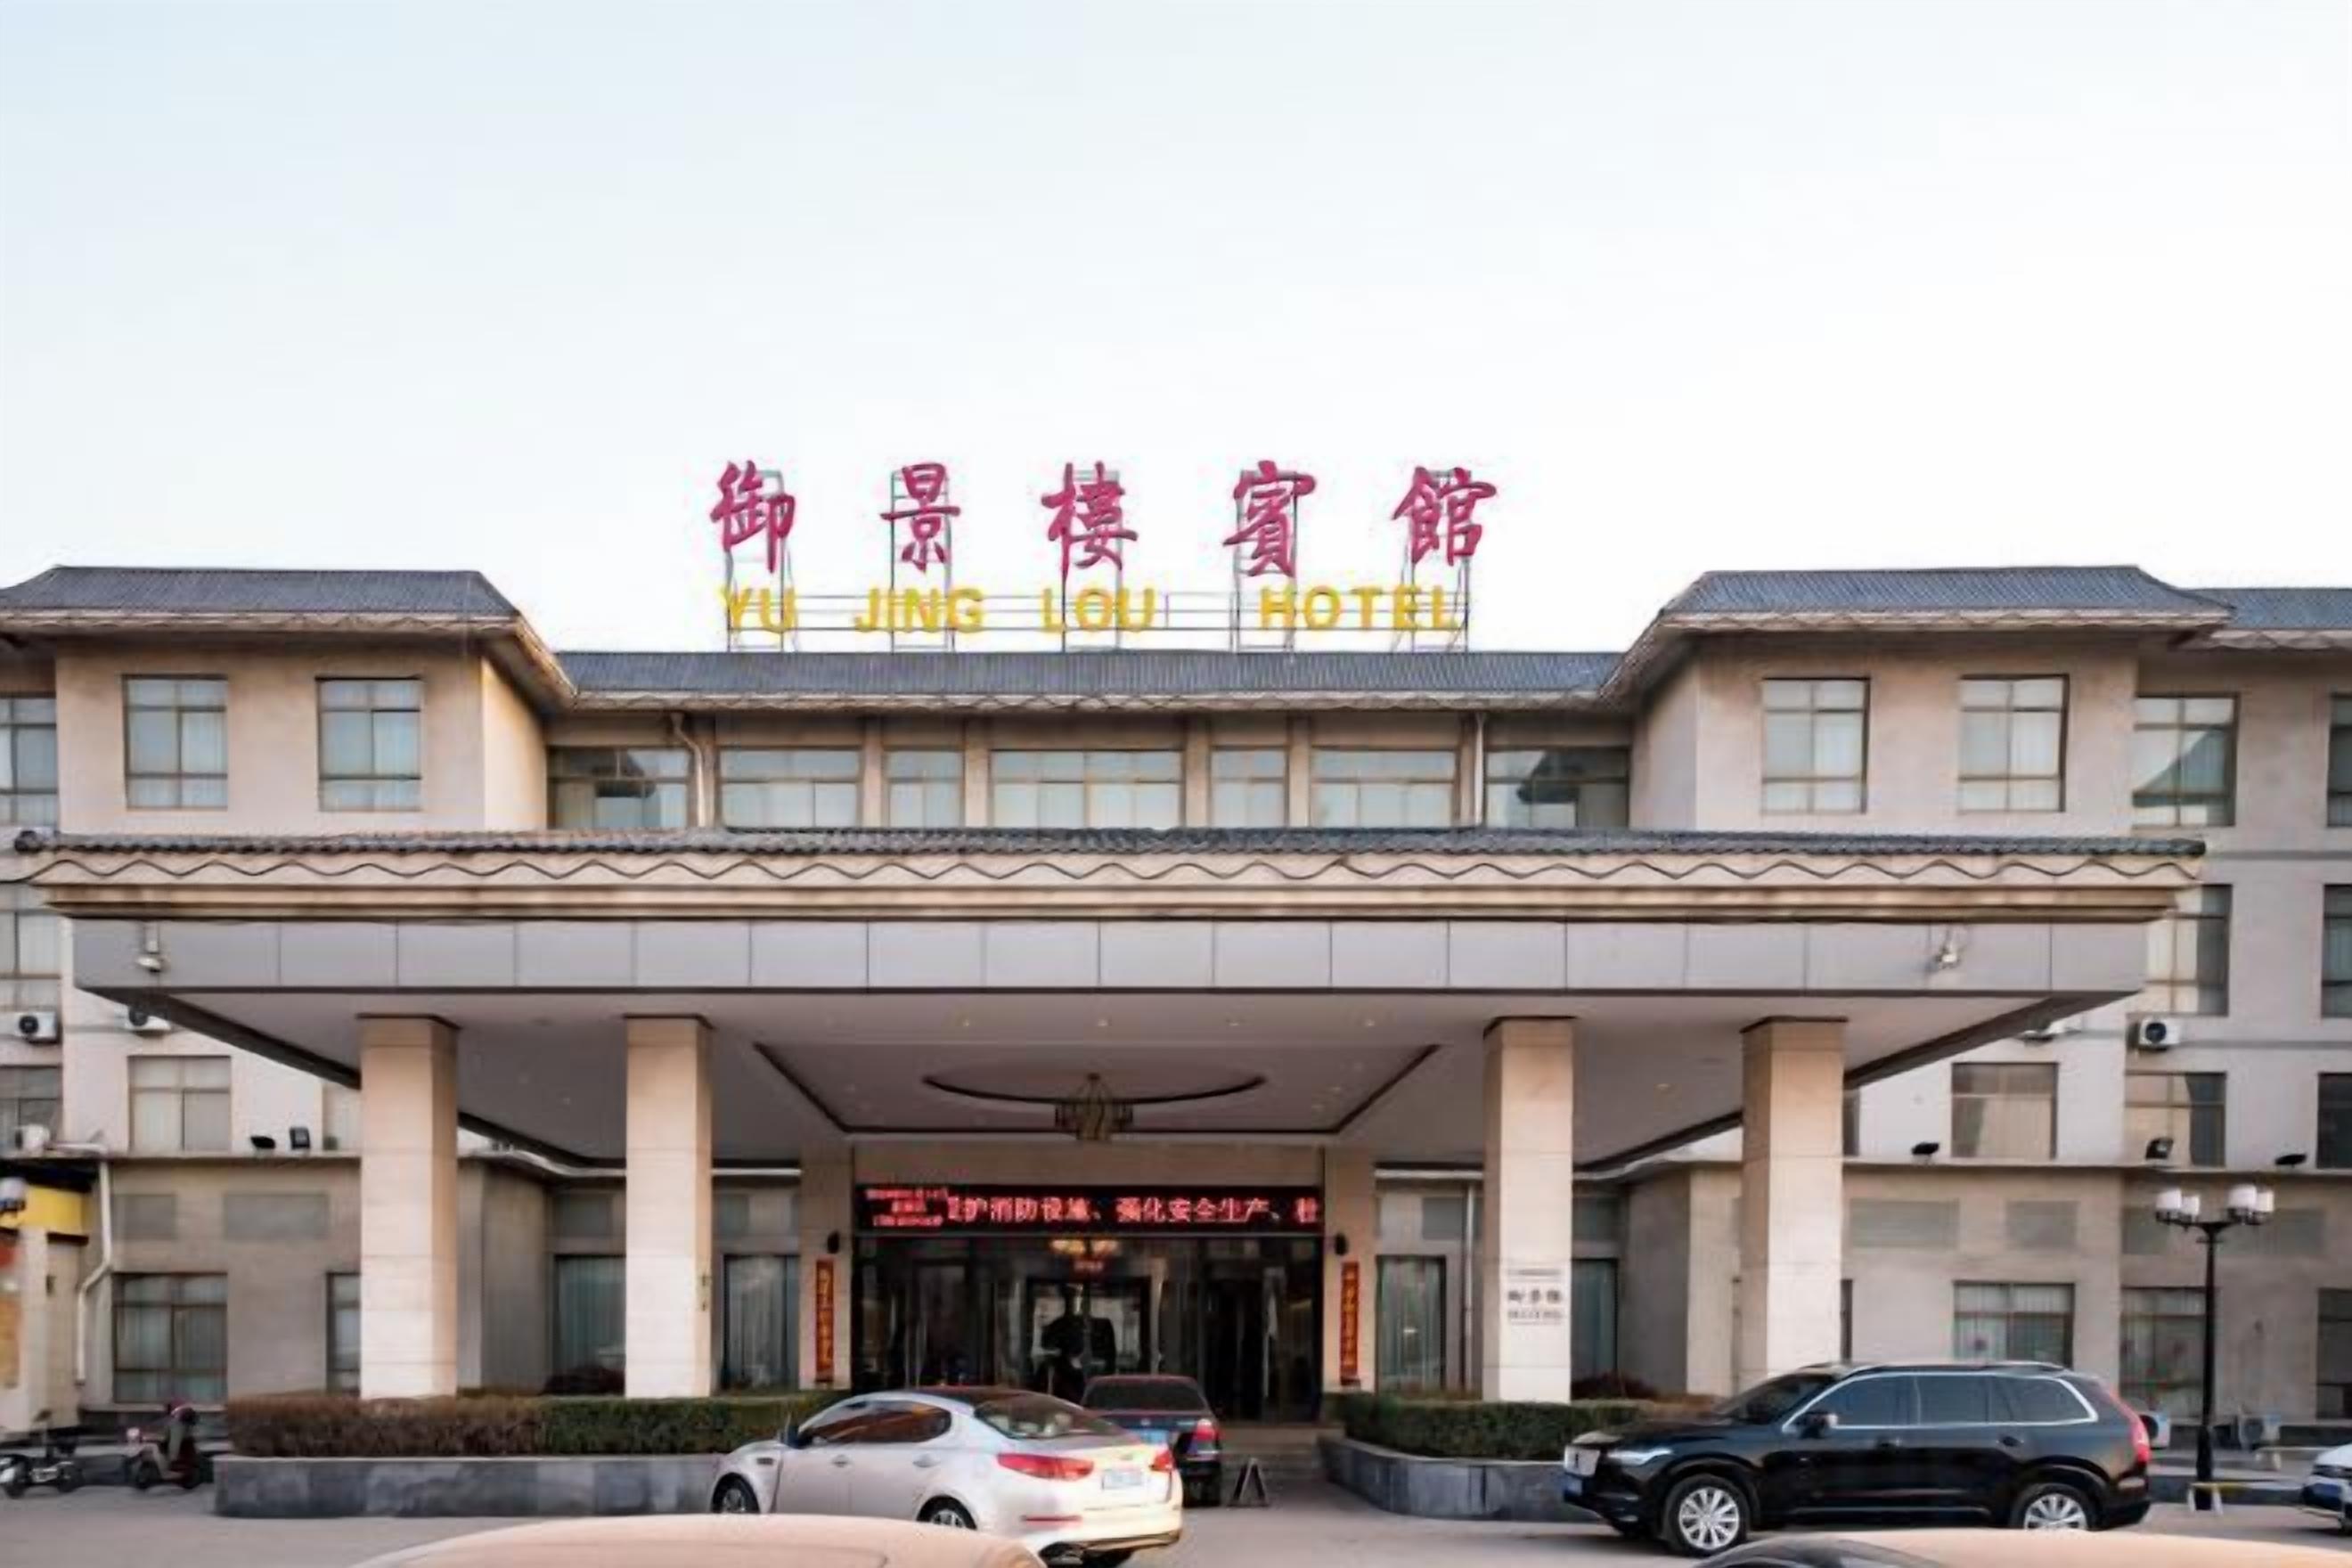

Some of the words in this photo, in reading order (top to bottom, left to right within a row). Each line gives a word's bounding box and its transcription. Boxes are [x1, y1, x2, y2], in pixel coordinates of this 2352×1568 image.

[722, 586, 796, 633] YU
[853, 587, 984, 633] JING
[1042, 588, 1156, 633] LOU
[1260, 587, 1457, 633] HOTEL
